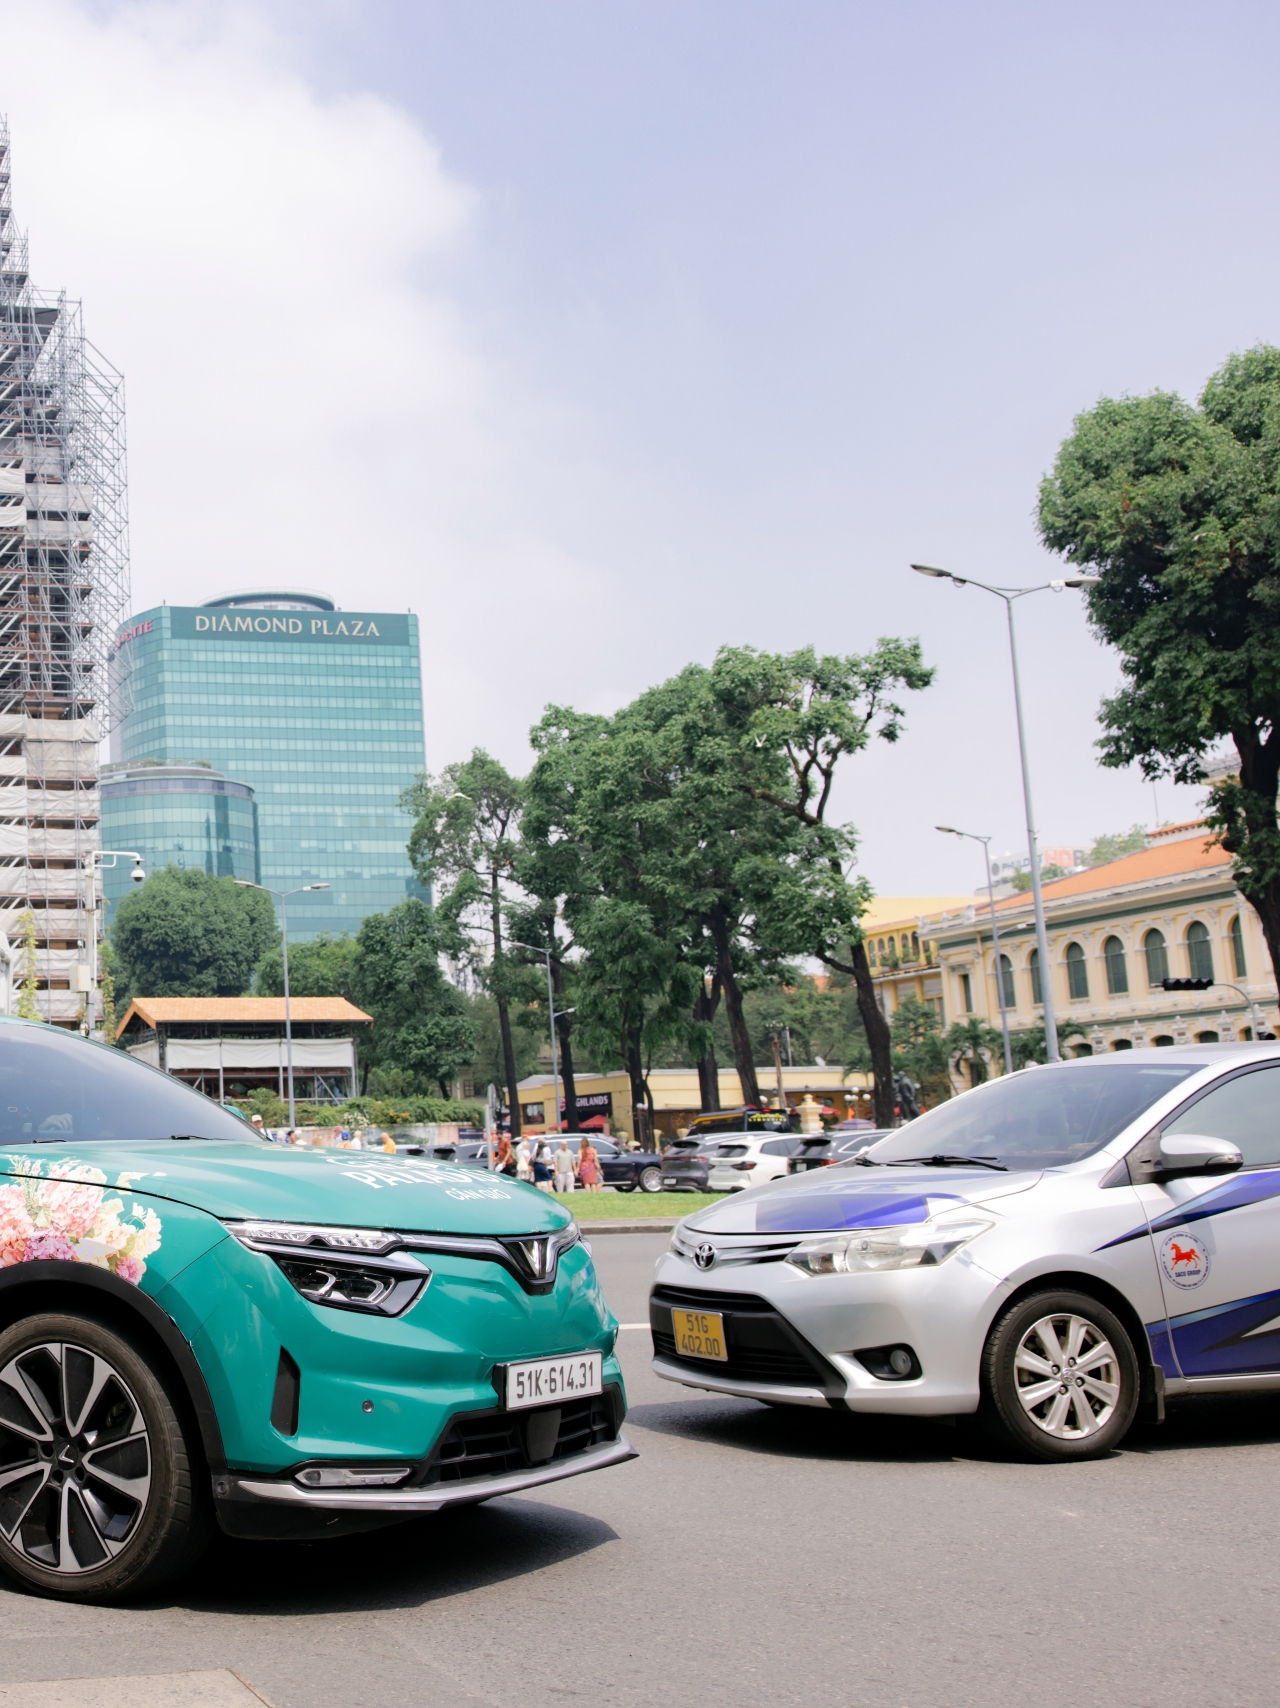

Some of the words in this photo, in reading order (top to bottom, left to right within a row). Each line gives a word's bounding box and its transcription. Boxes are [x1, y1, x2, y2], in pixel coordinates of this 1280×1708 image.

[195, 614, 303, 634] DIAMOND
[310, 619, 381, 637] PLAZA
[575, 1095, 609, 1107] GHLANDS
[686, 1313, 709, 1334] 51G
[681, 1334, 721, 1357] 402.00
